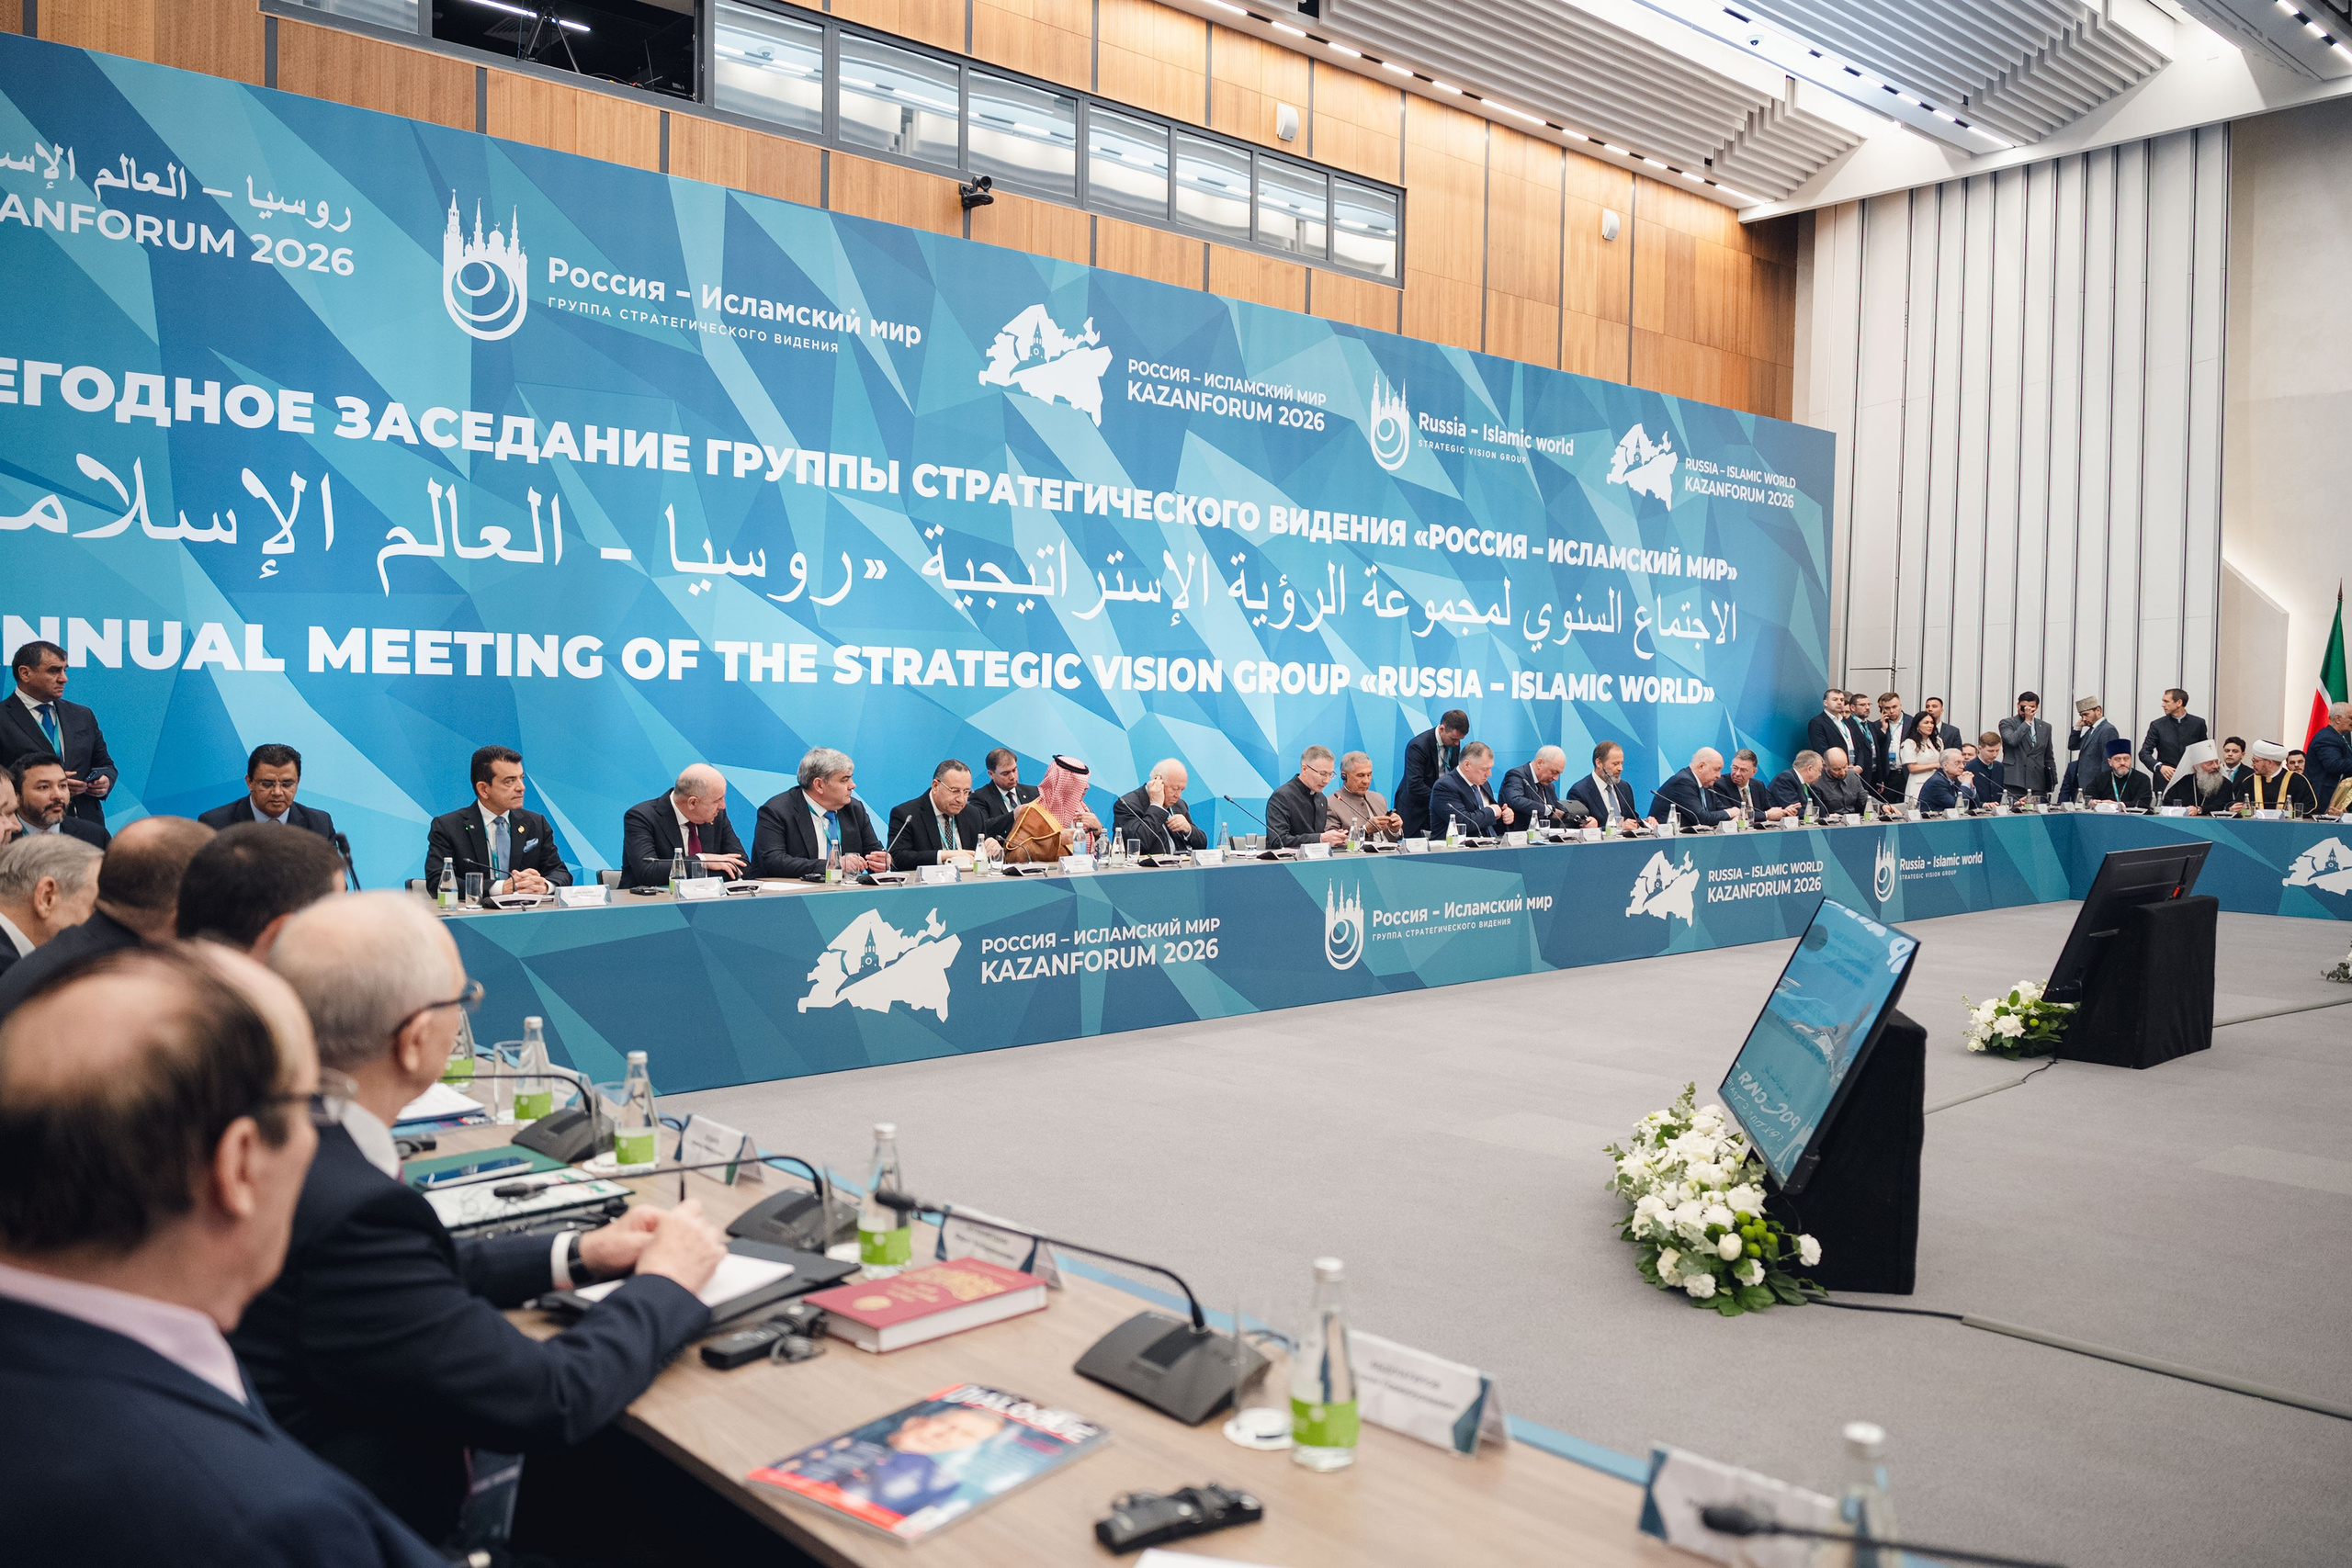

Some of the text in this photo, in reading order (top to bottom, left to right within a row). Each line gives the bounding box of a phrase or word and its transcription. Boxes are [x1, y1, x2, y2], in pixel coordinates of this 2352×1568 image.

[94, 152, 187, 202] العالم
[246, 174, 353, 233] روسيا
[0, 193, 356, 276] ANFORUM 2026
[548, 256, 665, 301] Россия
[700, 284, 862, 334] Исламский
[870, 318, 922, 348] мир
[548, 296, 839, 353] ГРУППА СТРАТЕГИЧЕСКОГО ВИДЕНИЯ
[1128, 382, 1326, 432] KAZANFORUM 2026
[1129, 358, 1191, 383] РОССИЯ
[1204, 372, 1294, 400] ИСЛАМСКИЙ
[1297, 389, 1328, 407] МИР
[1418, 439, 1528, 463] STRATEGIC VISION GROUP
[1419, 412, 1466, 438] Russia
[1483, 423, 1532, 449] Islamic
[1535, 436, 1575, 457] world
[334, 396, 690, 472] ЗАСЕДАНИЕ
[707, 438, 899, 494] ГРУППЫ
[912, 464, 1261, 533] СТРАТЕГИЧЕСКОГО
[1269, 504, 1407, 547] ВИДЕНИЯ
[1414, 524, 1528, 559] «РОССИЯ
[1548, 537, 1681, 576] ИСЛАМСКИЙ
[1686, 555, 1737, 581] МИР»
[1684, 476, 1795, 509] KAZANFORUM 2026
[1685, 457, 1719, 475] RUSSIA
[1727, 465, 1763, 483] ISLAMIC
[1764, 471, 1797, 489] WORLD
[377, 477, 562, 597] العالم
[1227, 552, 1346, 633] الرؤية
[1362, 564, 1511, 637] لمجموعة
[1523, 587, 1622, 653] السنوي
[1634, 594, 1736, 660] الاجتماع
[308, 626, 604, 679] MEETING
[621, 637, 700, 681] OF
[714, 640, 818, 683] THE
[832, 644, 1082, 690] STRATEGIC
[1091, 654, 1223, 693] VISION
[1232, 660, 1351, 695] GROUP
[1359, 665, 1484, 699] «RUSSIA
[1511, 671, 1613, 702] ISLAMIC
[1619, 675, 1715, 705] WORLD»
[1708, 867, 1744, 883] RUSSIA
[1751, 863, 1789, 878] ISLAMIC
[1790, 860, 1824, 874] WORLD
[1899, 856, 1926, 871] Russia
[1933, 852, 1961, 868] Islamic
[1962, 851, 1984, 865] world
[1373, 908, 1429, 928] Россия
[1444, 893, 1522, 919] Исламский
[1526, 895, 1553, 912] мир
[1707, 876, 1822, 903] KAZANFORUM 2026
[981, 932, 1057, 954] РОССИЯ
[1073, 917, 1182, 945] ИСЛАМСКИЙ
[1186, 917, 1222, 934] МИР
[1372, 918, 1511, 942] ГРУППА СТРАТЕГИЧЕСКОГО ВИДЕНИЯ
[981, 937, 1219, 985] KAZANFORUM 2026
